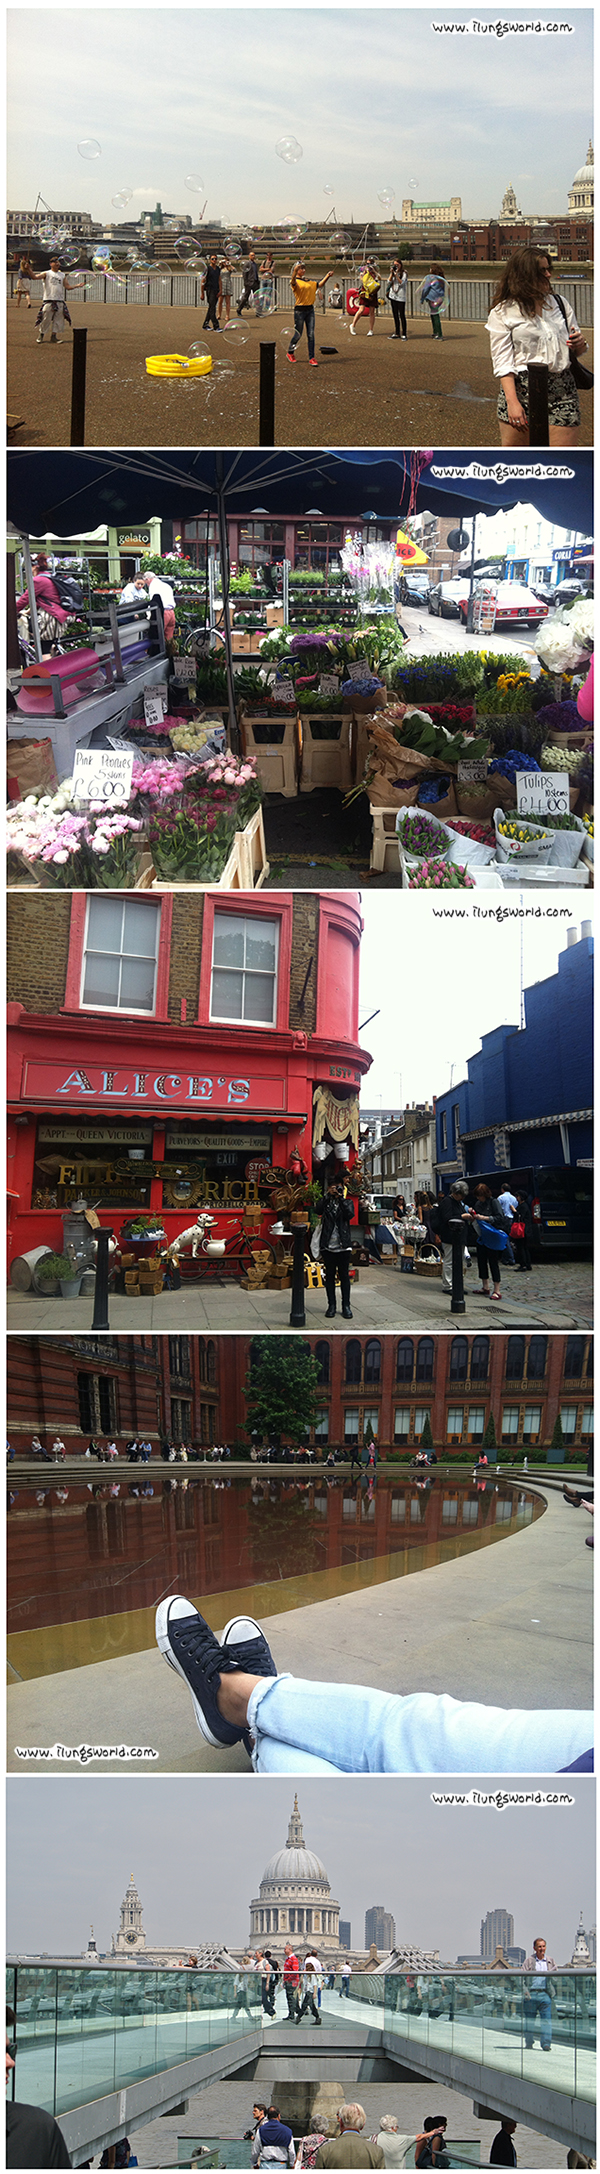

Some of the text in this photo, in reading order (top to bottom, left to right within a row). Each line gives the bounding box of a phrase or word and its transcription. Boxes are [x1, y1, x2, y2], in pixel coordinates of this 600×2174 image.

[119, 533, 149, 544] gelato
[76, 752, 93, 765] Pink
[94, 768, 106, 780] 5
[518, 774, 553, 789] Tulips
[56, 1070, 250, 1103] ALICE'S
[76, 1129, 104, 1141] QUEEN
[107, 1130, 146, 1140] VICTORIA
[217, 1153, 236, 1164] EXIT
